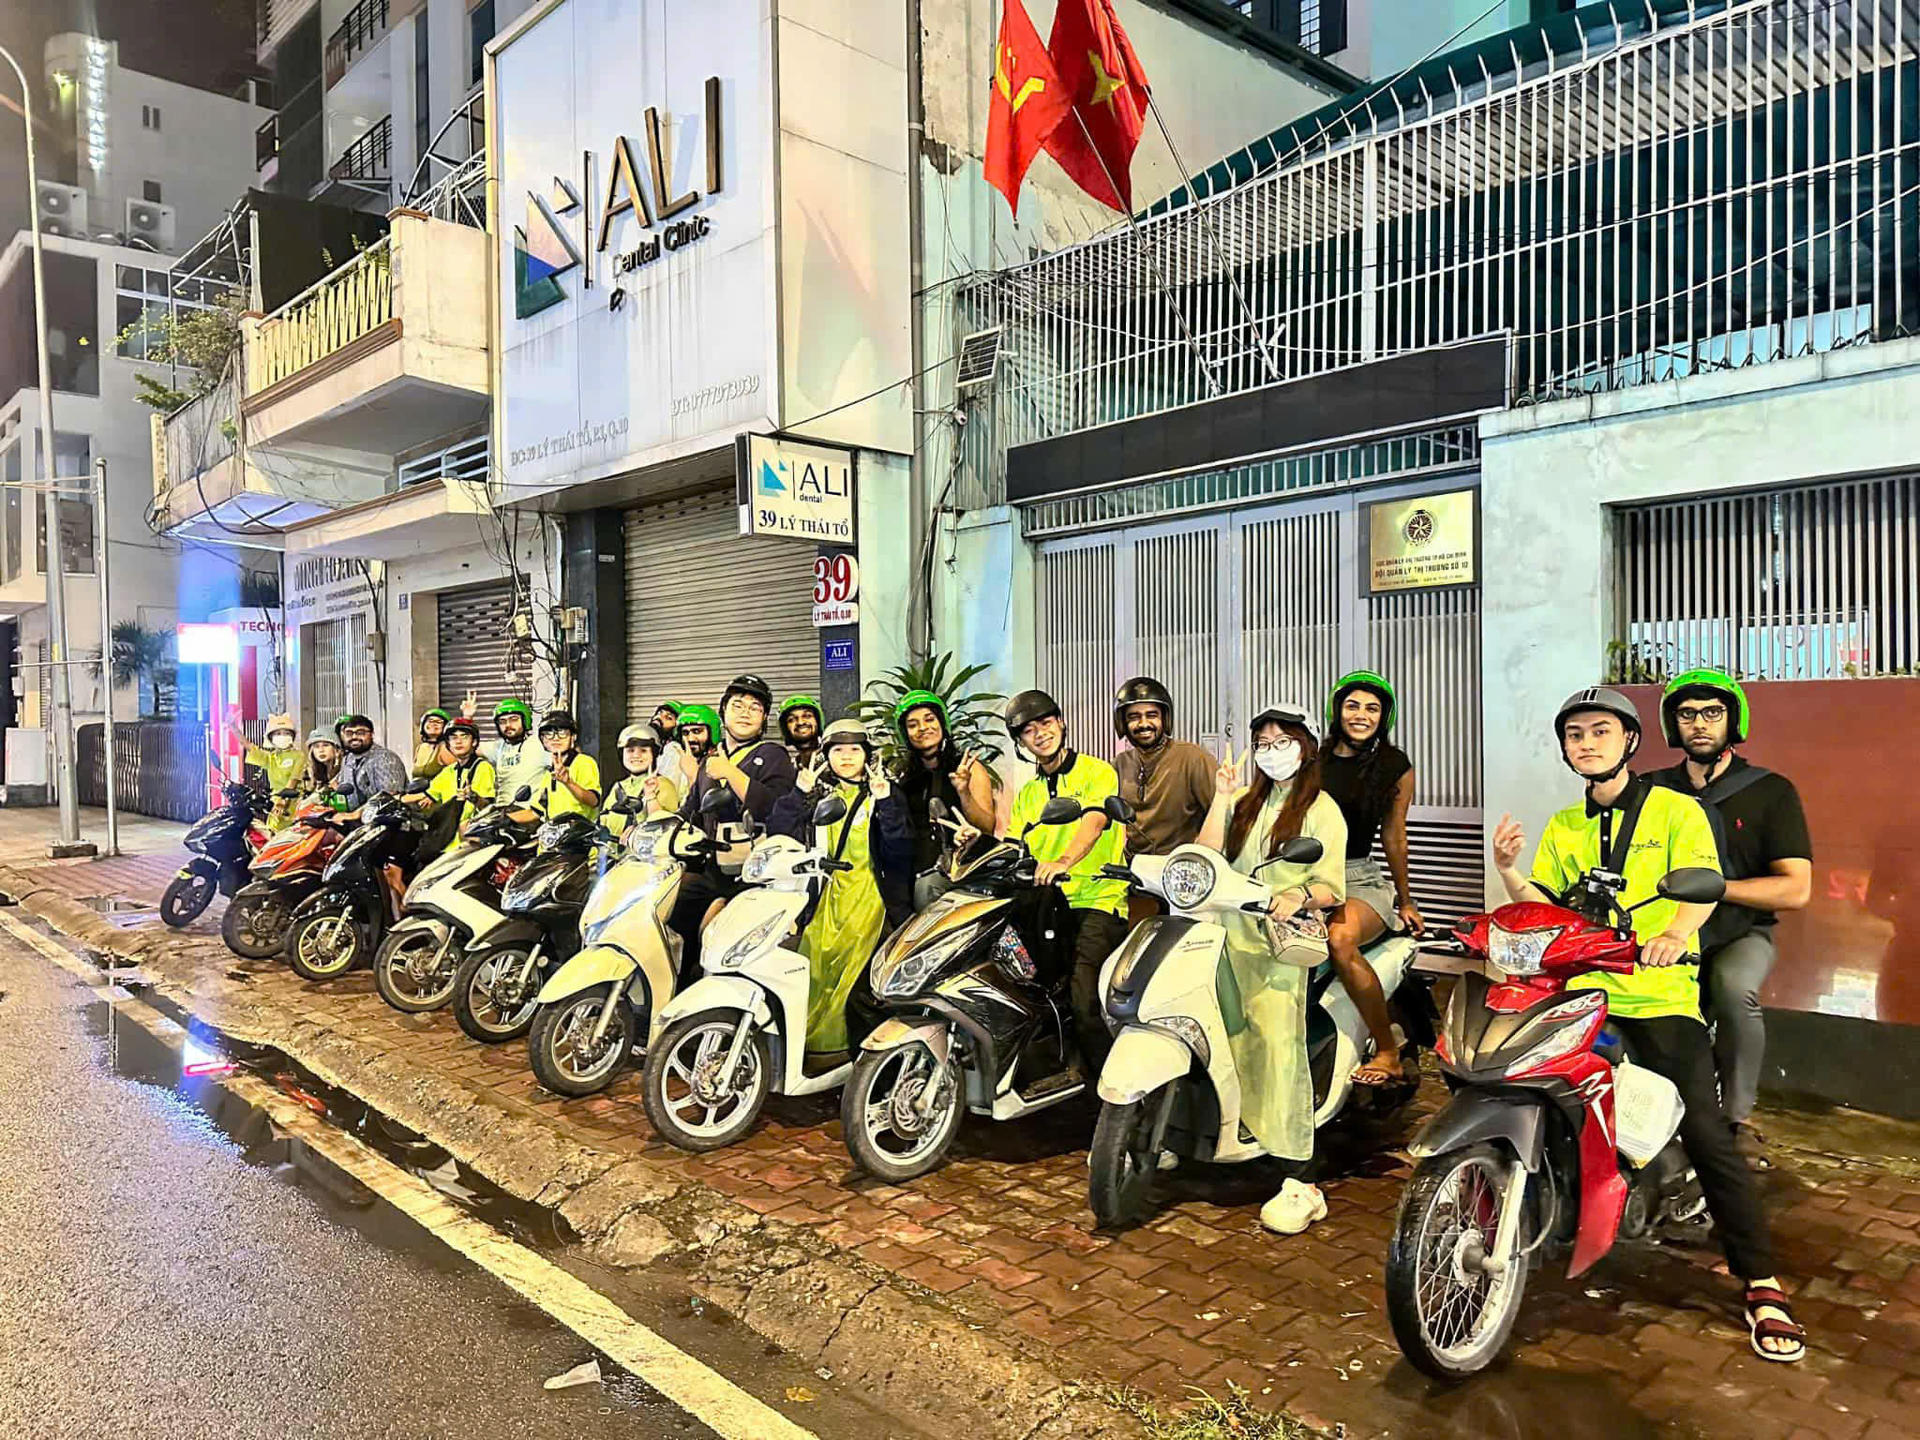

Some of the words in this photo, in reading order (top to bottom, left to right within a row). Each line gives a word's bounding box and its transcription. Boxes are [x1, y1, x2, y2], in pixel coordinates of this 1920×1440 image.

[597, 76, 721, 252] ALI
[664, 215, 709, 251] Clinic
[800, 462, 847, 497] ALI
[800, 493, 823, 503] dental
[759, 510, 776, 528] 39
[780, 515, 796, 531] LÝ
[799, 517, 830, 535] THÁI
[832, 518, 849, 536] TỔ
[813, 554, 851, 604] 39
[831, 647, 847, 657] ALI
